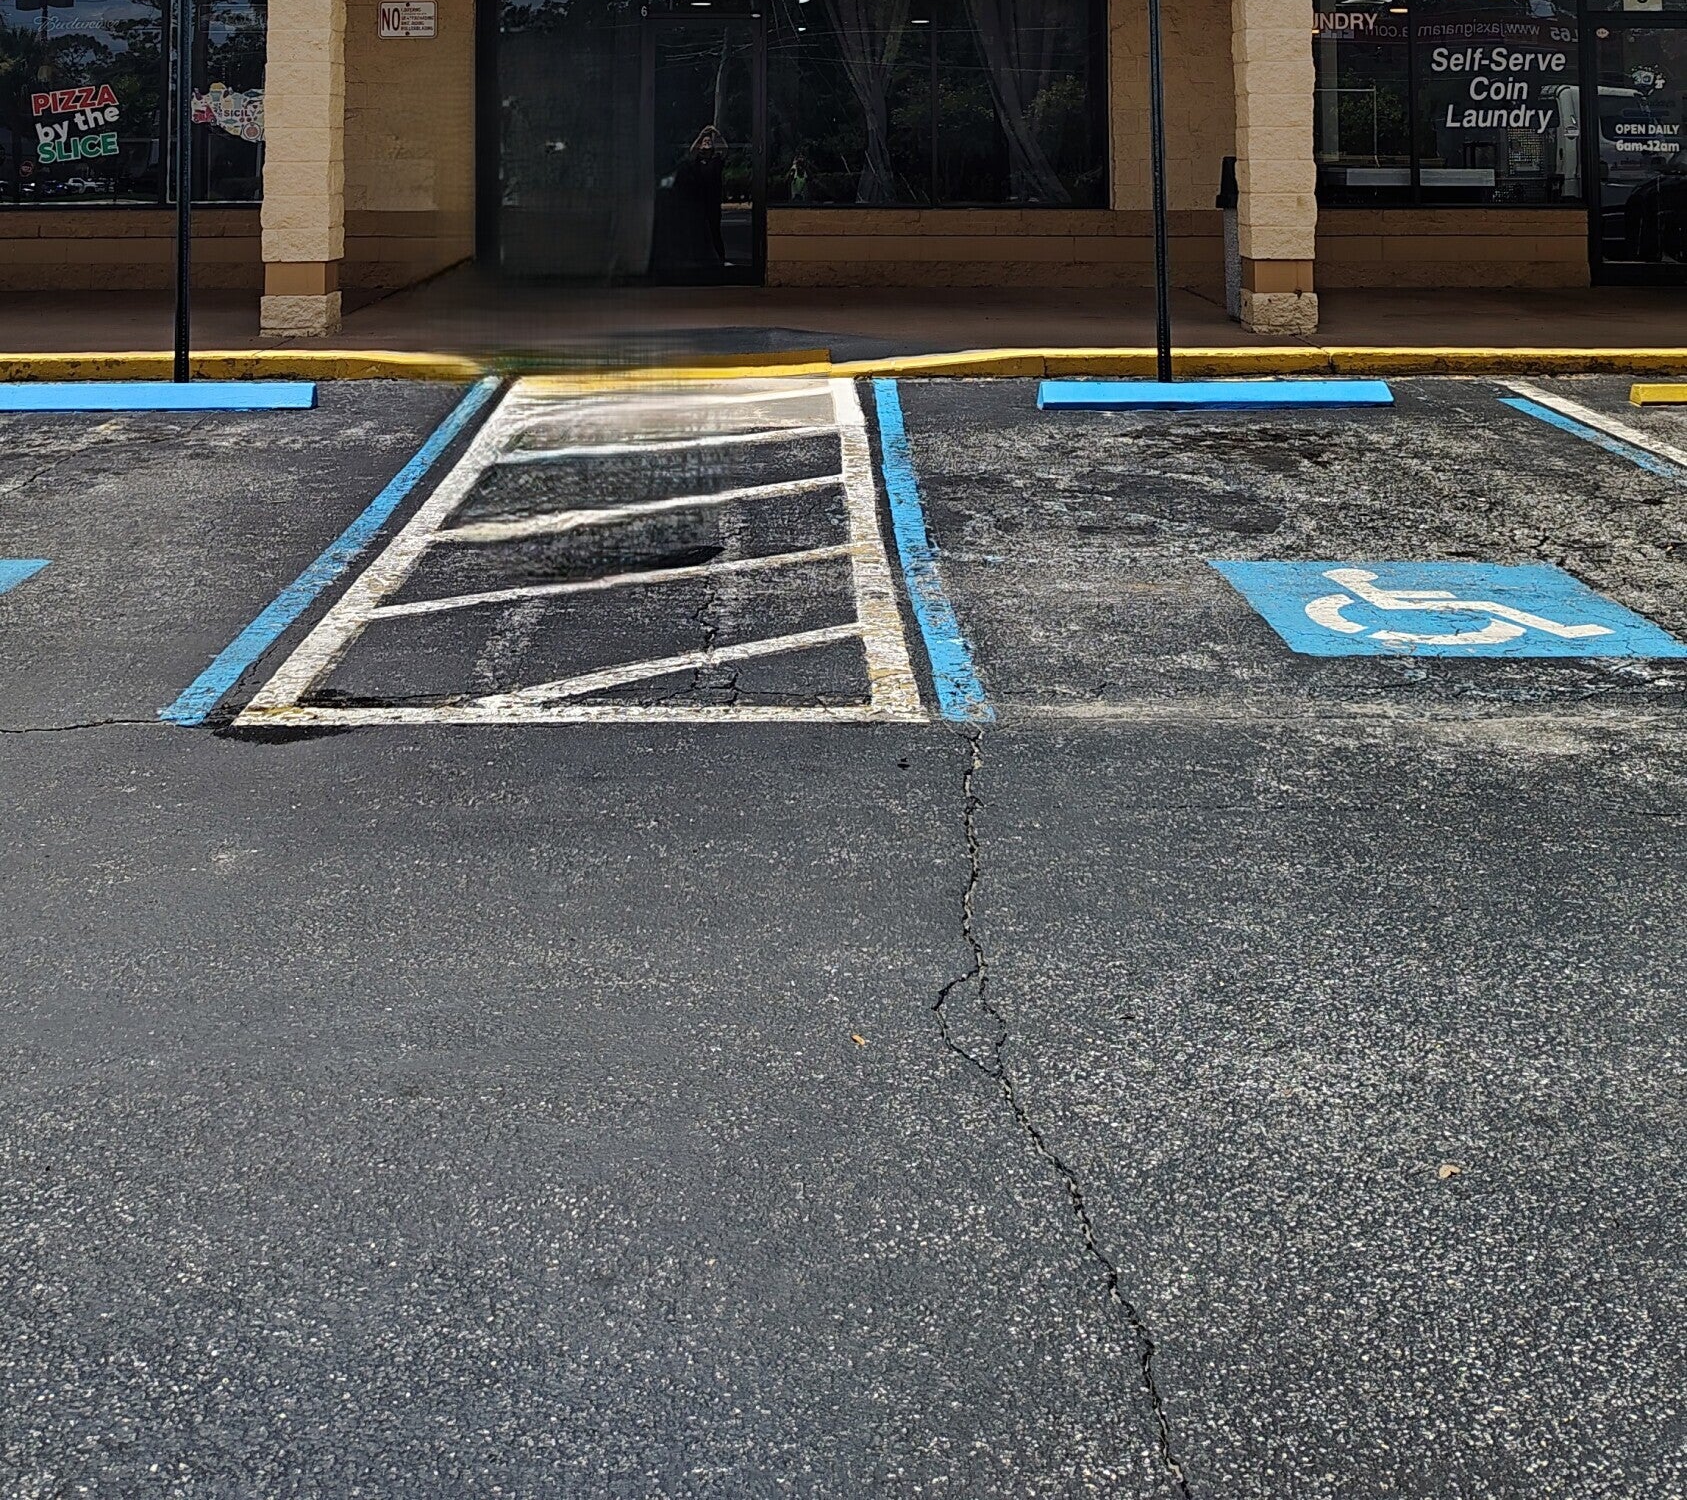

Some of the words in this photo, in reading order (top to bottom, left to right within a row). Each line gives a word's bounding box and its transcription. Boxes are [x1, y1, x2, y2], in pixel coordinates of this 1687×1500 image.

[382, 7, 401, 31] NO
[1431, 47, 1566, 71] Self-Serve
[31, 84, 119, 116] PIZZA
[1469, 76, 1529, 100] Coin
[35, 121, 69, 144] by
[74, 106, 120, 131] the
[223, 109, 256, 117] SICILY
[1445, 104, 1553, 134] Laundry
[1615, 124, 1646, 135] OPEN
[1648, 124, 1680, 135] DAILY
[37, 131, 119, 164] SLICE
